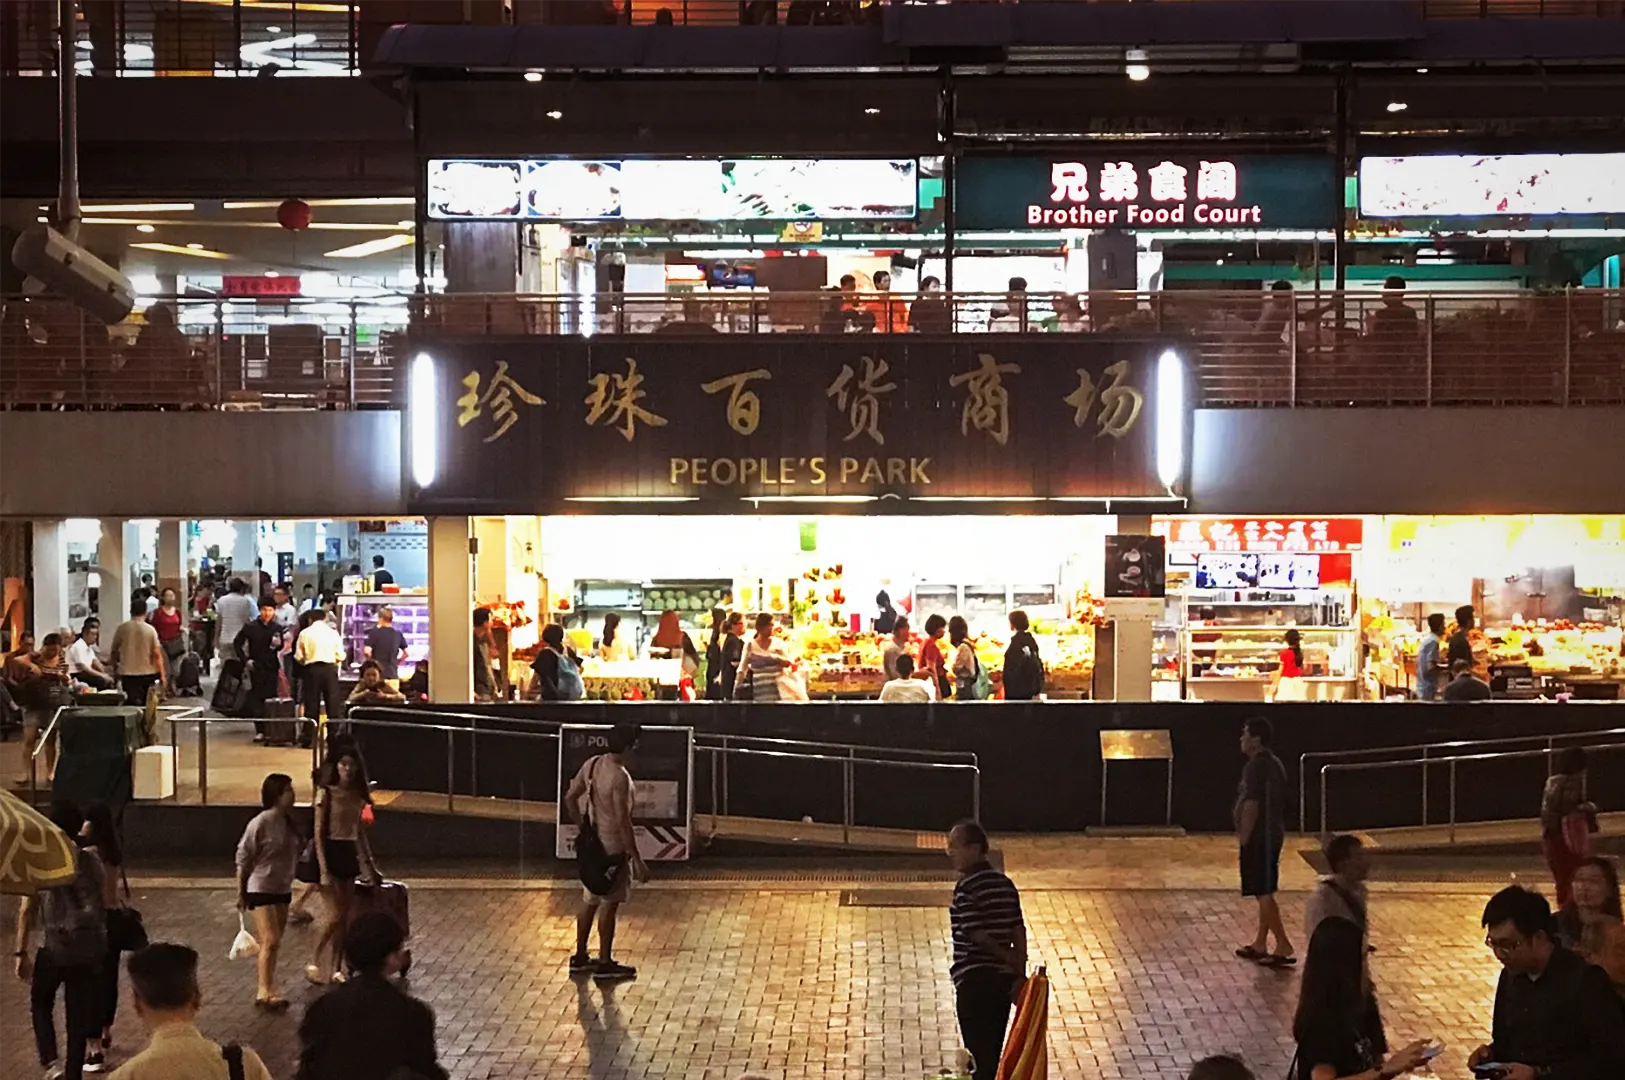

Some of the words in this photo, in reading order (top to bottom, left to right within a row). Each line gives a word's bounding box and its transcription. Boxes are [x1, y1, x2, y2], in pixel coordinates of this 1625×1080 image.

[1027, 203, 1119, 224] Brother
[1126, 203, 1185, 224] Food
[1193, 204, 1262, 224] Court
[457, 356, 1144, 446] 珍珠百货商场
[669, 456, 827, 485] PEOPLE'S
[839, 456, 932, 485] PARK
